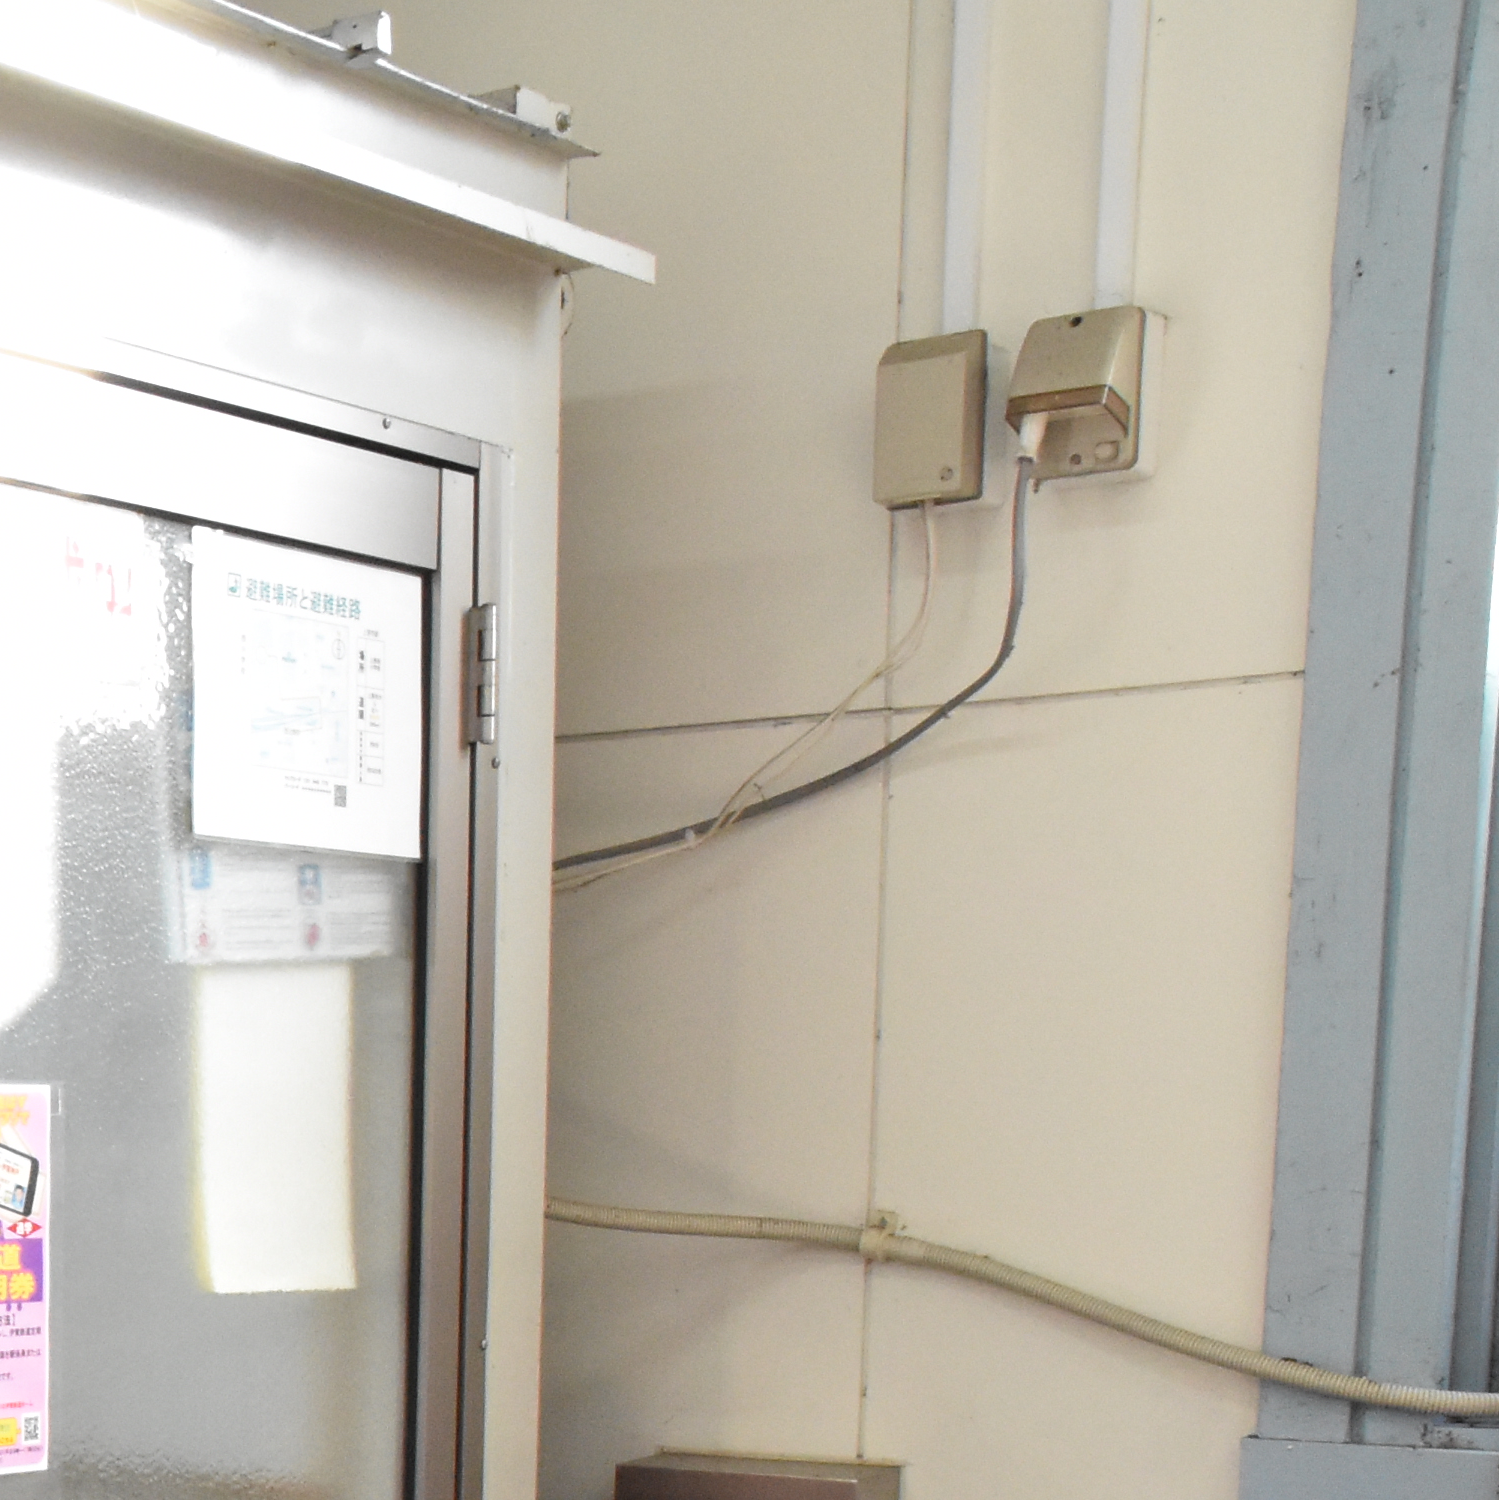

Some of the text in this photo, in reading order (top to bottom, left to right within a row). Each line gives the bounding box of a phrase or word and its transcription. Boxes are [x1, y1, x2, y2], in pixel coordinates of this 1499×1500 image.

[246, 577, 361, 620] 避難場所と避難経路
